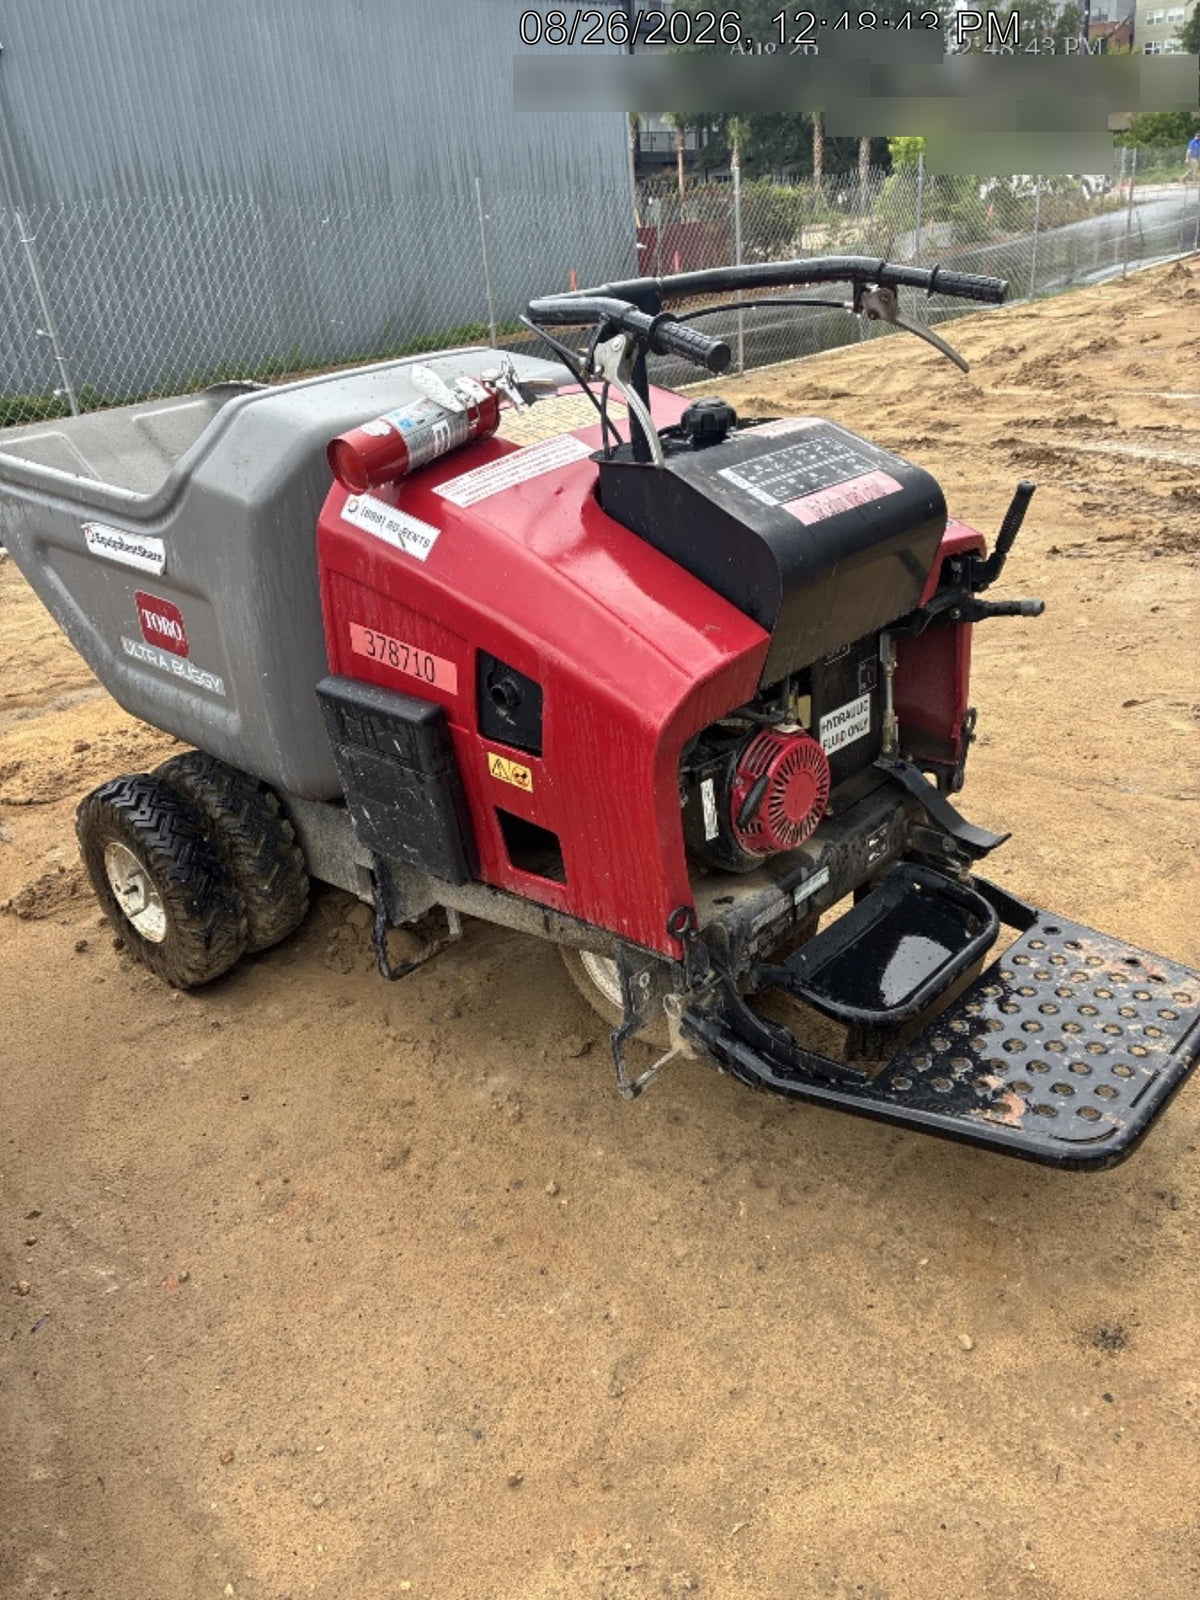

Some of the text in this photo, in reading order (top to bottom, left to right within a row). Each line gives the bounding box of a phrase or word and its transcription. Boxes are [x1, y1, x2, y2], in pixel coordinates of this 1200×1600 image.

[141, 608, 184, 641] TORO
[122, 640, 170, 671] ULTRA
[364, 630, 435, 683] 378710
[821, 699, 869, 732] HYDRAULIC
[823, 716, 869, 750] FLUID ONLY
